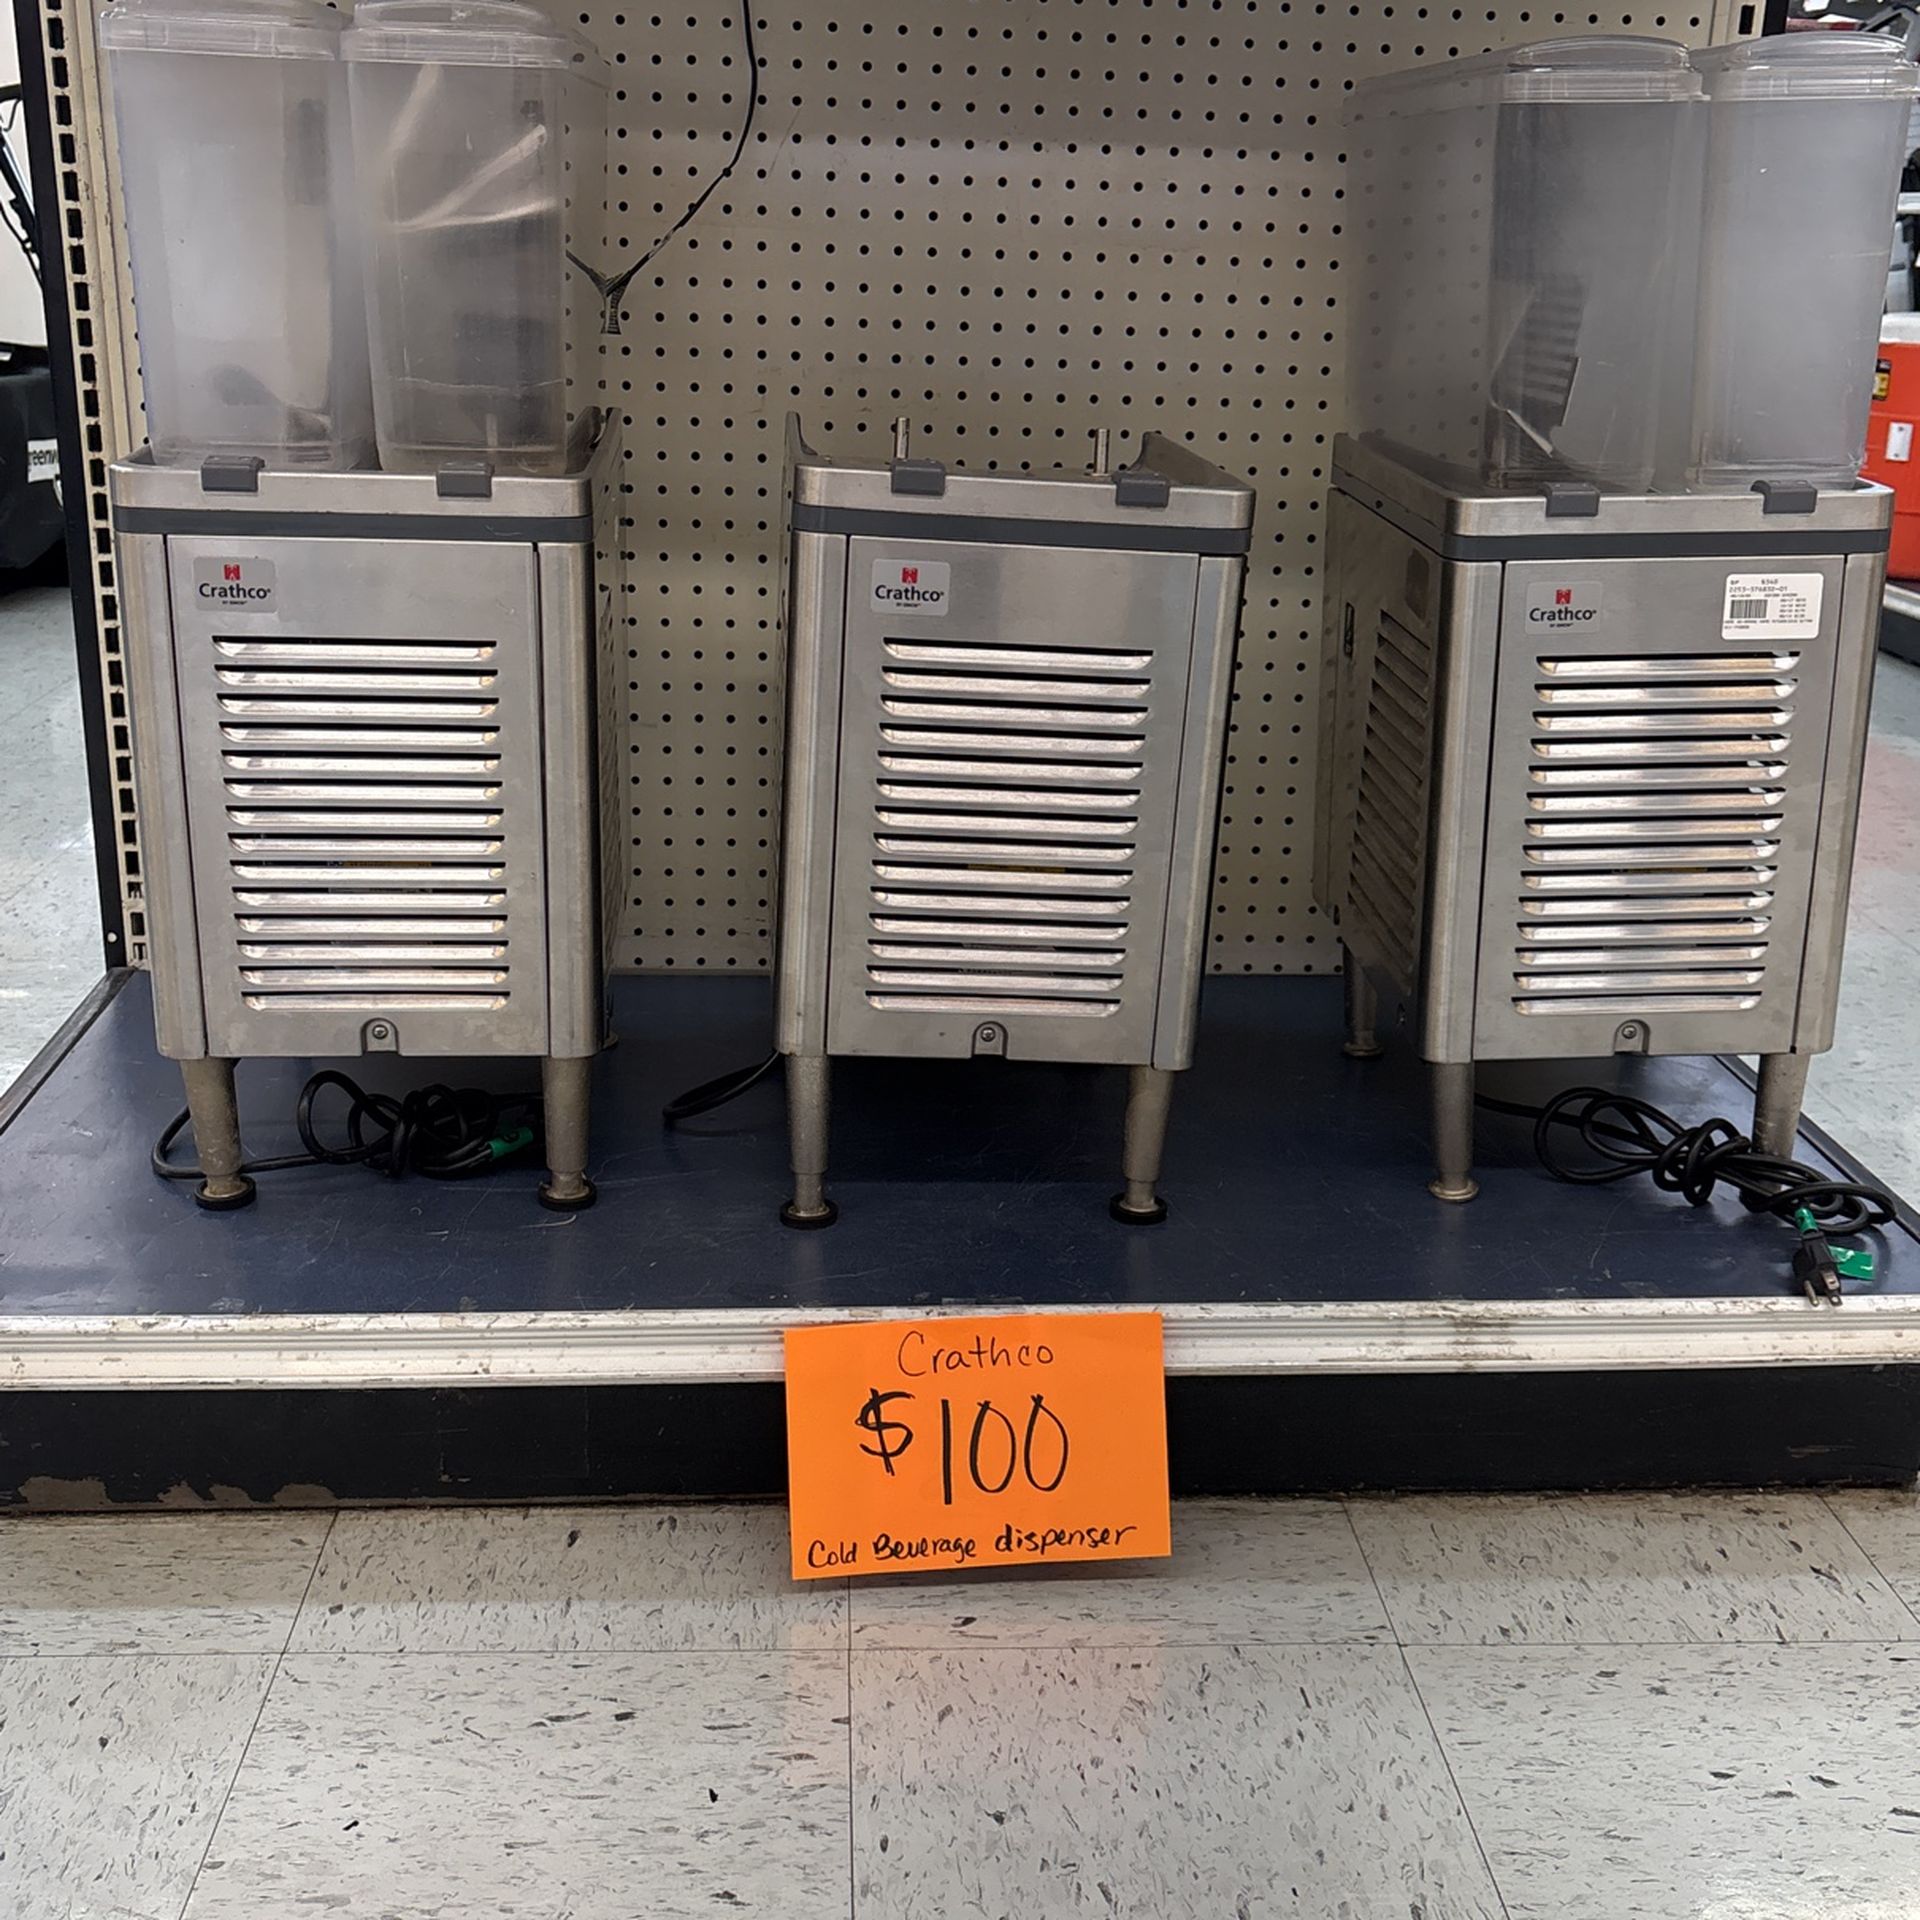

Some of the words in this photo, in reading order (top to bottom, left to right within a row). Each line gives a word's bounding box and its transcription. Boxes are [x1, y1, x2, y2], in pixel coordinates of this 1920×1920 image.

[199, 583, 267, 599] Crathco
[875, 584, 941, 602] Crathco
[1530, 606, 1593, 622] Crathco
[898, 1331, 1054, 1377] Crathco
[855, 1387, 1069, 1506] $100
[808, 1540, 857, 1569] Cold
[873, 1533, 977, 1563] Beverage
[995, 1524, 1138, 1556] dispenser
